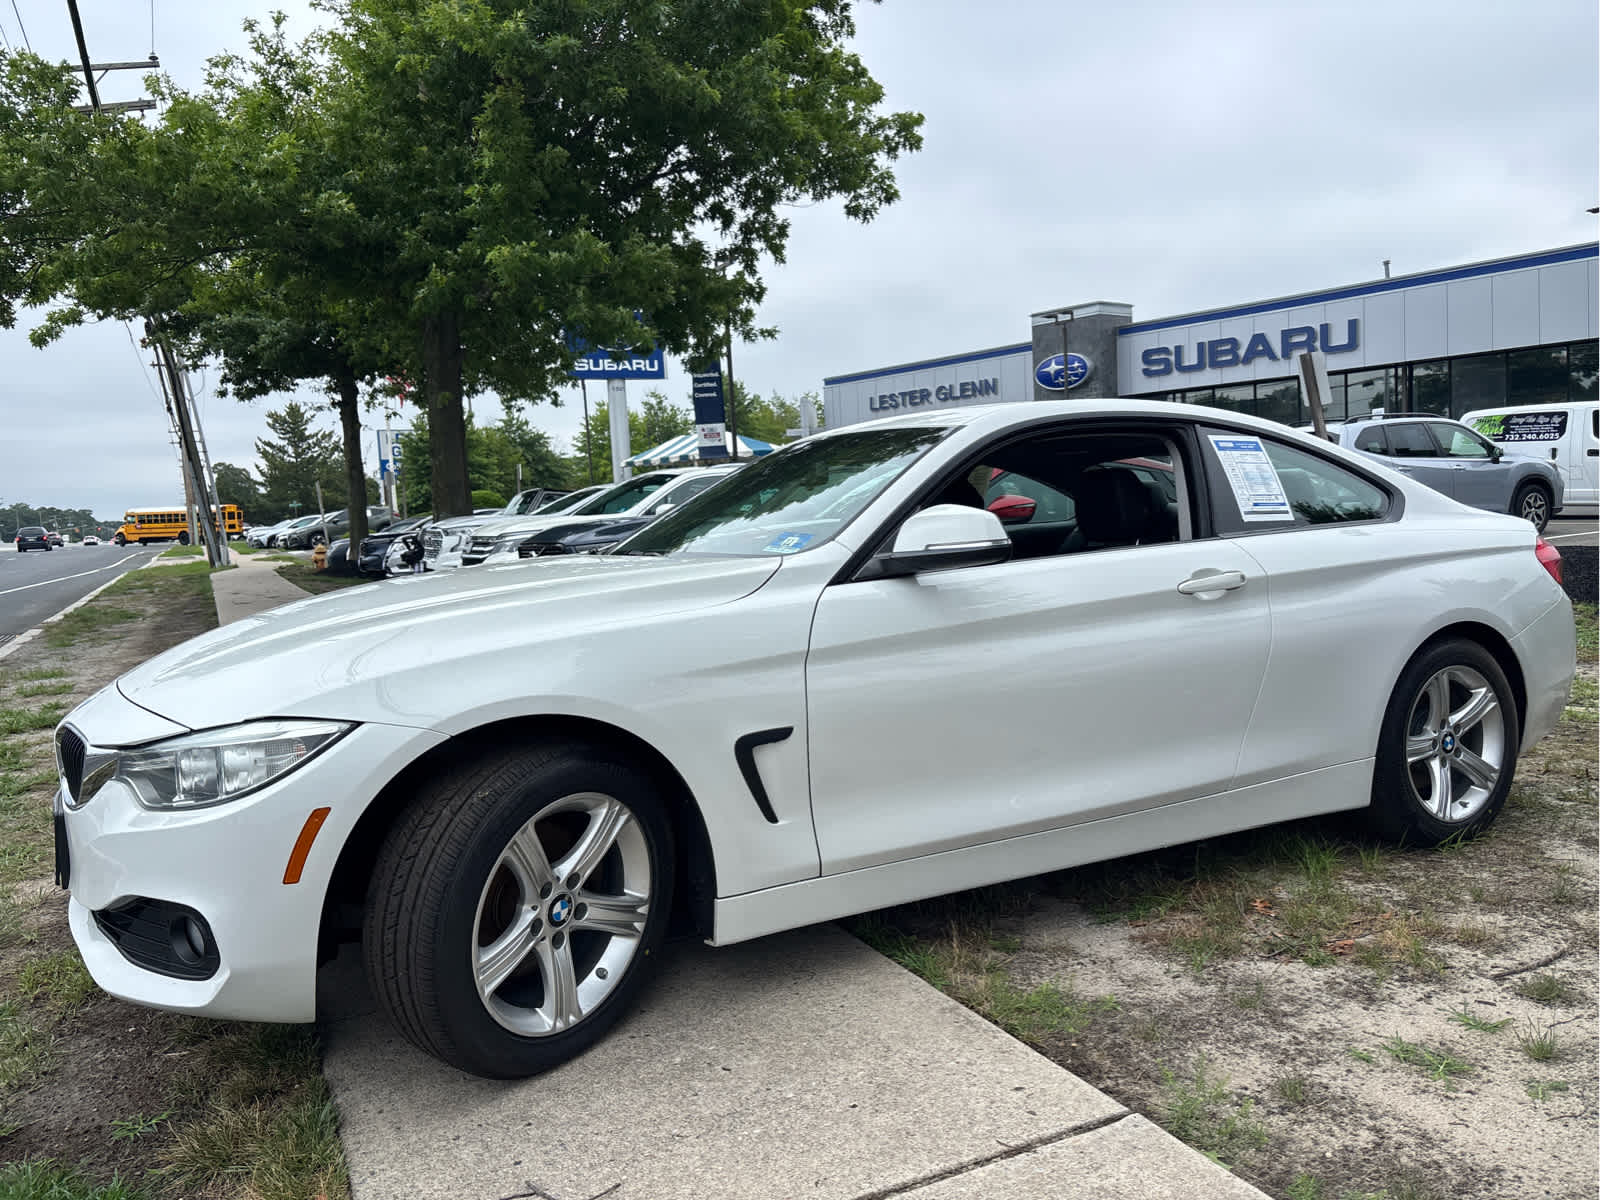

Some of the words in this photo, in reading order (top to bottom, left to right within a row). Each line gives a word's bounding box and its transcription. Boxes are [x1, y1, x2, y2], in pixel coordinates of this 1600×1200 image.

[574, 359, 658, 371] SUBARU
[1141, 318, 1359, 377] SUBARU
[869, 388, 933, 412] LESTER
[935, 377, 999, 402] GLENN
